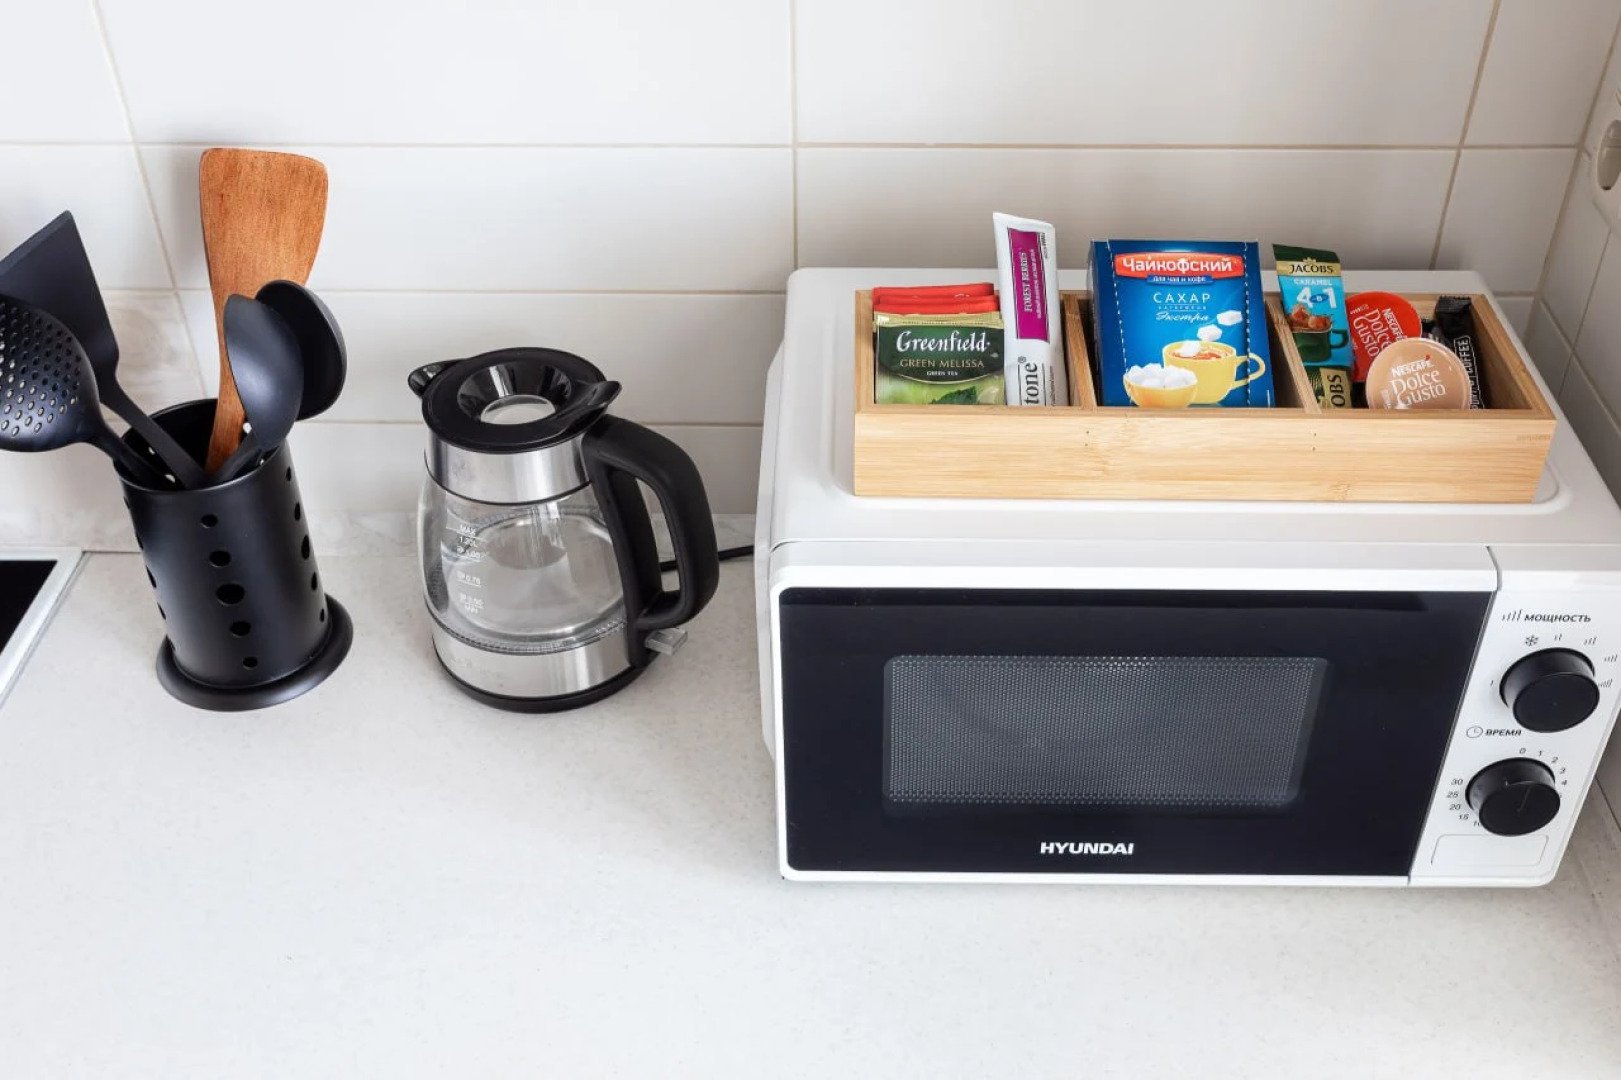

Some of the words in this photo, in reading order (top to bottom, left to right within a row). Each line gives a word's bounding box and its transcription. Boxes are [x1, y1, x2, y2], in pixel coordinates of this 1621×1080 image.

[1020, 252, 1029, 281] BERRIES
[1122, 255, 1233, 274] Чайкофский
[1289, 264, 1334, 274] JACOBS
[1187, 275, 1207, 283] кофе
[1293, 278, 1333, 286] CARAMEL
[1022, 282, 1033, 313] FOREST
[1153, 292, 1211, 304] САХАР
[1155, 310, 1210, 323] Экстра
[895, 330, 987, 353] Greenfield
[900, 359, 937, 369] GREEN
[939, 359, 985, 368] MELISSA
[1389, 369, 1440, 396] Dolce
[1397, 383, 1447, 408] Gusto
[459, 523, 477, 537] MAX
[1524, 613, 1592, 623] МОЩНОСТЬ
[1485, 728, 1522, 737] ВРЕМЯ
[1519, 747, 1527, 755] 0
[1559, 767, 1566, 775] 3
[1451, 778, 1464, 786] 30
[1446, 790, 1459, 799] 25
[1449, 803, 1461, 811] 20
[1459, 813, 1469, 821] 15
[1040, 841, 1135, 855] HYUNDAI
